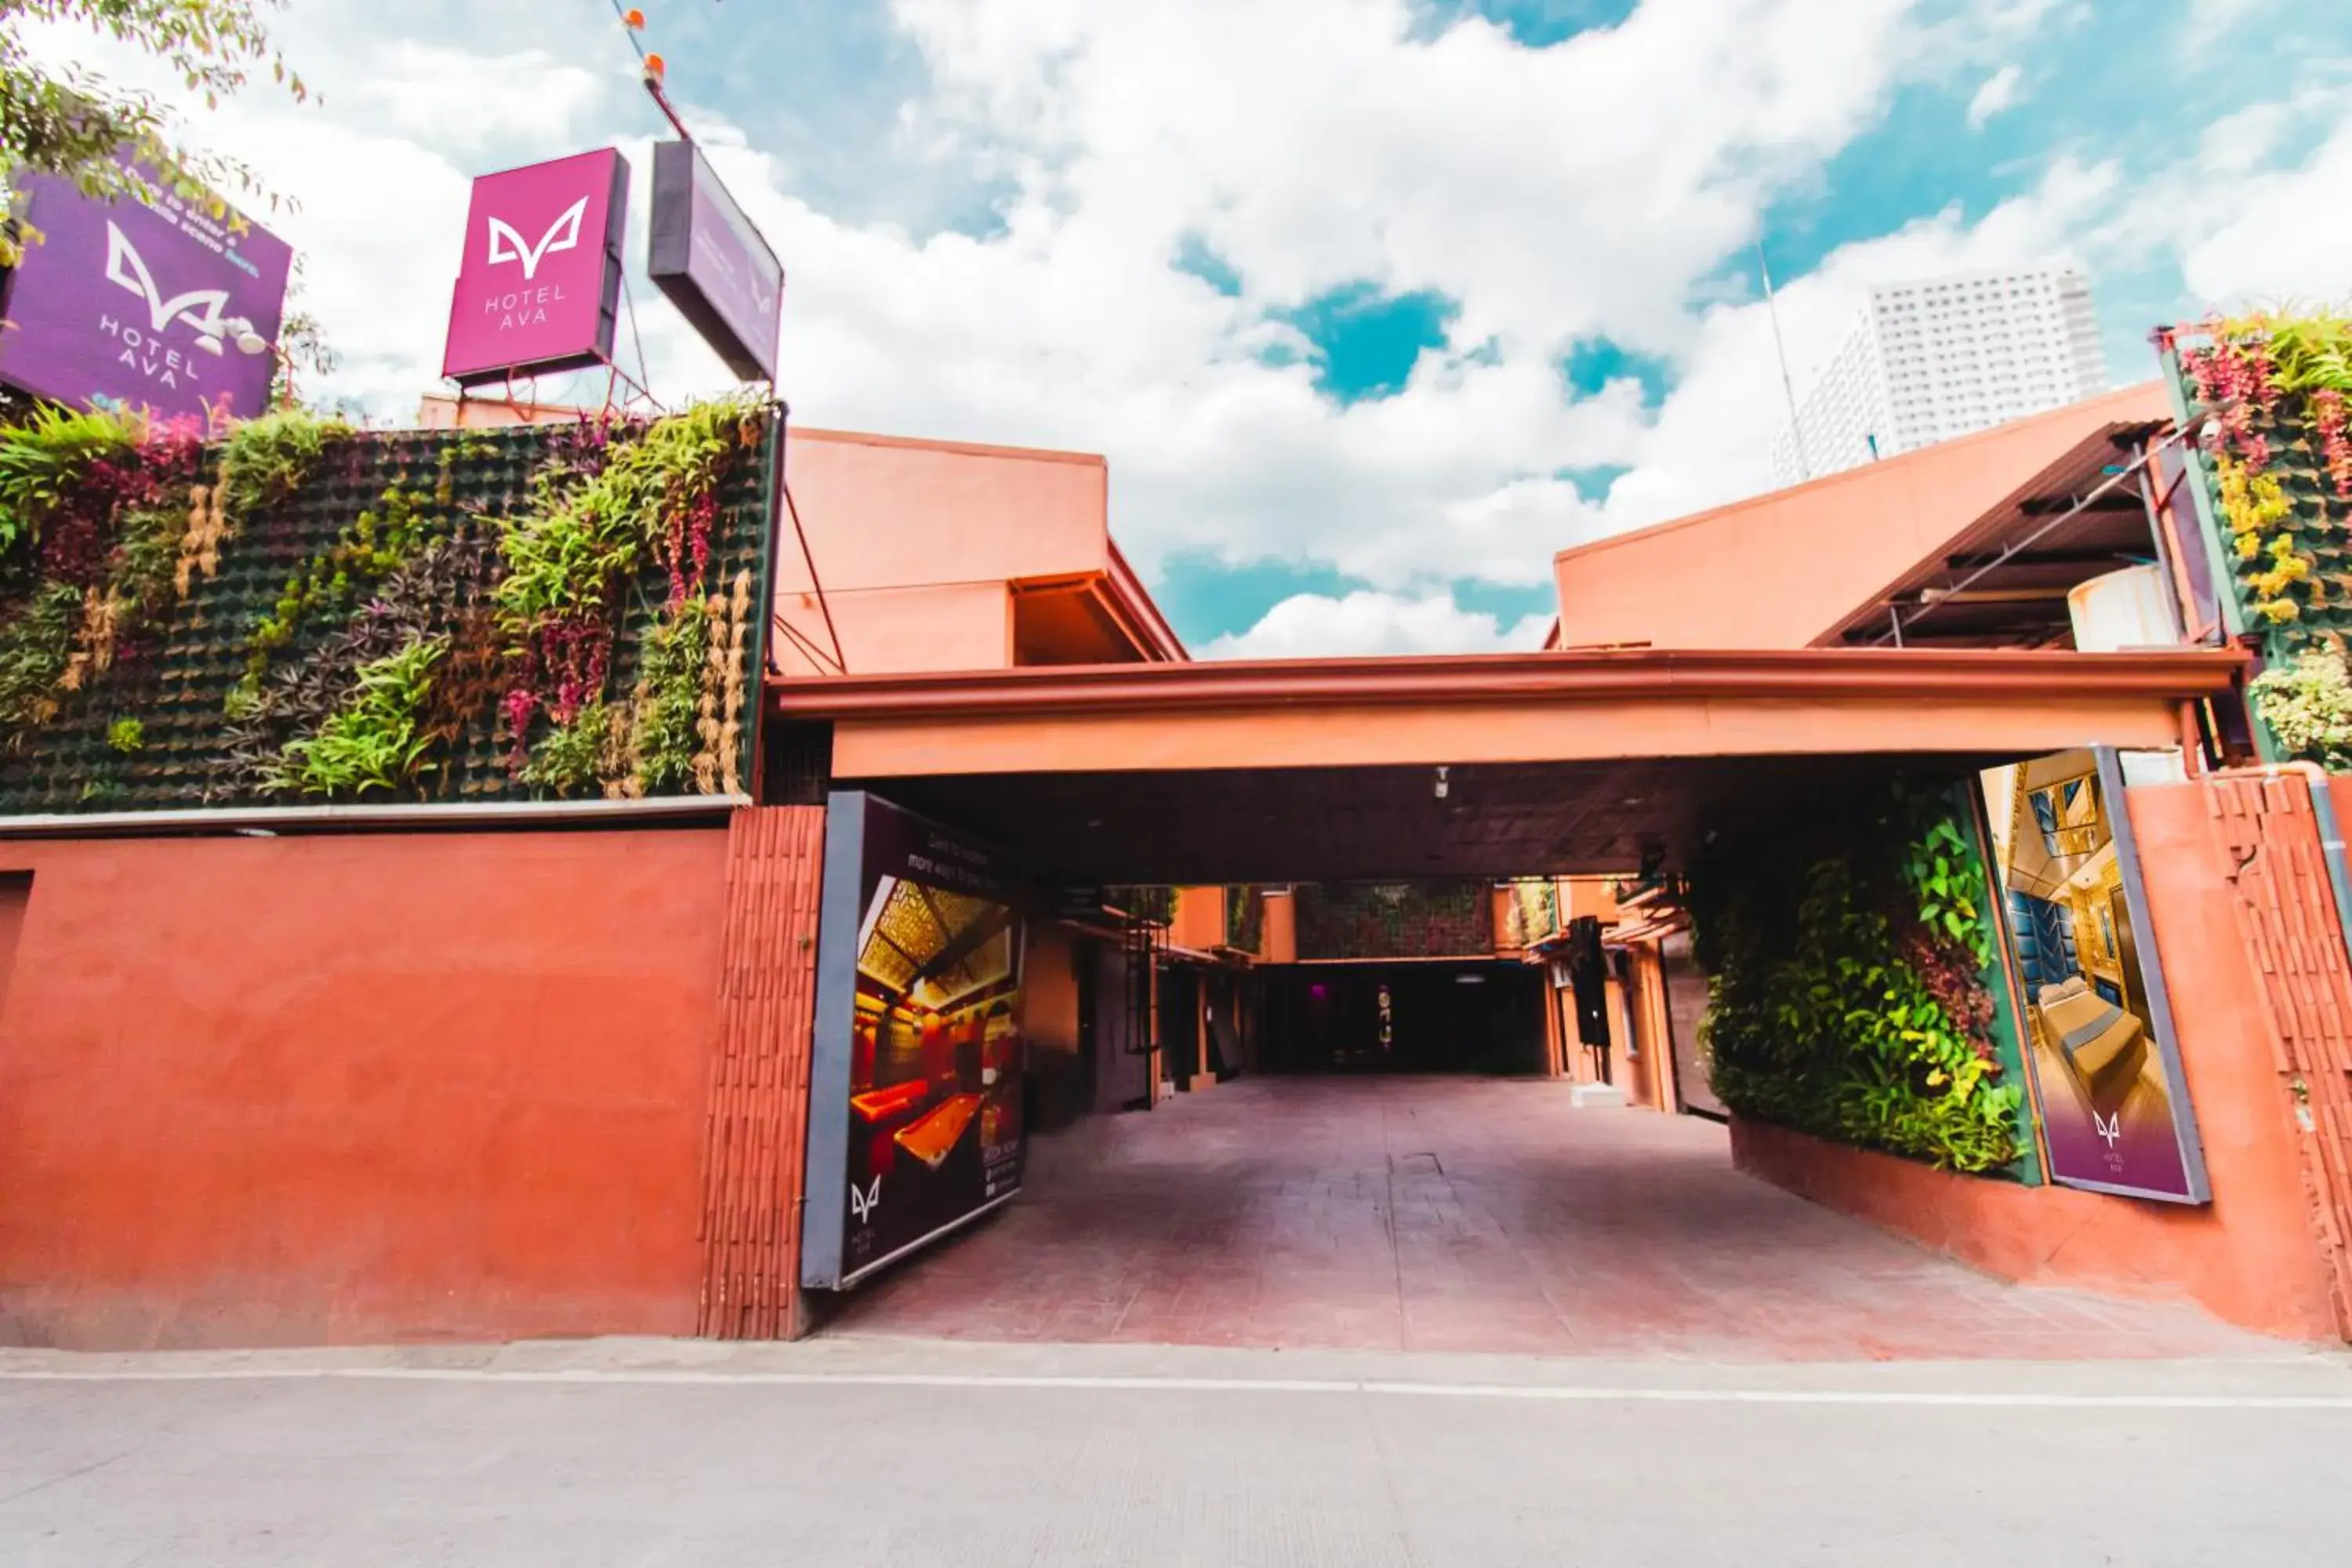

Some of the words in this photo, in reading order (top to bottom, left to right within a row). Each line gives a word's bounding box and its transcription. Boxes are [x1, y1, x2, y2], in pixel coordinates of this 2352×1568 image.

[484, 283, 565, 314] HOTEL
[499, 308, 546, 331] AVA
[100, 314, 198, 380] HOTEL
[119, 348, 176, 390] AVA
